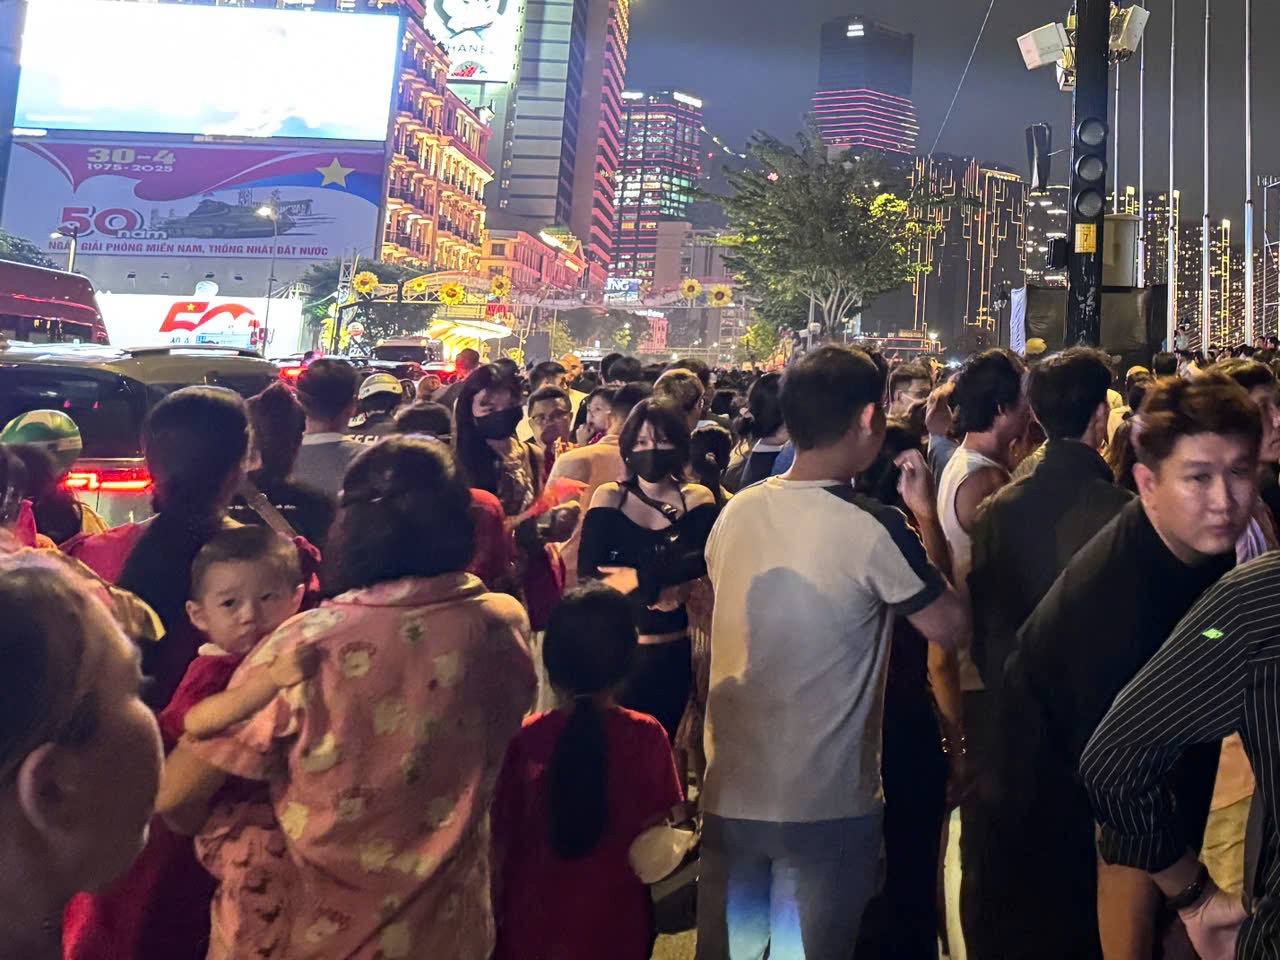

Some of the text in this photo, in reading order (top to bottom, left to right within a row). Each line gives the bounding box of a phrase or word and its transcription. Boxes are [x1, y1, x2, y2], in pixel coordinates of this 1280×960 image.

[86, 148, 176, 165] 30-4
[58, 206, 144, 238] 50
[177, 244, 206, 254] NAM,
